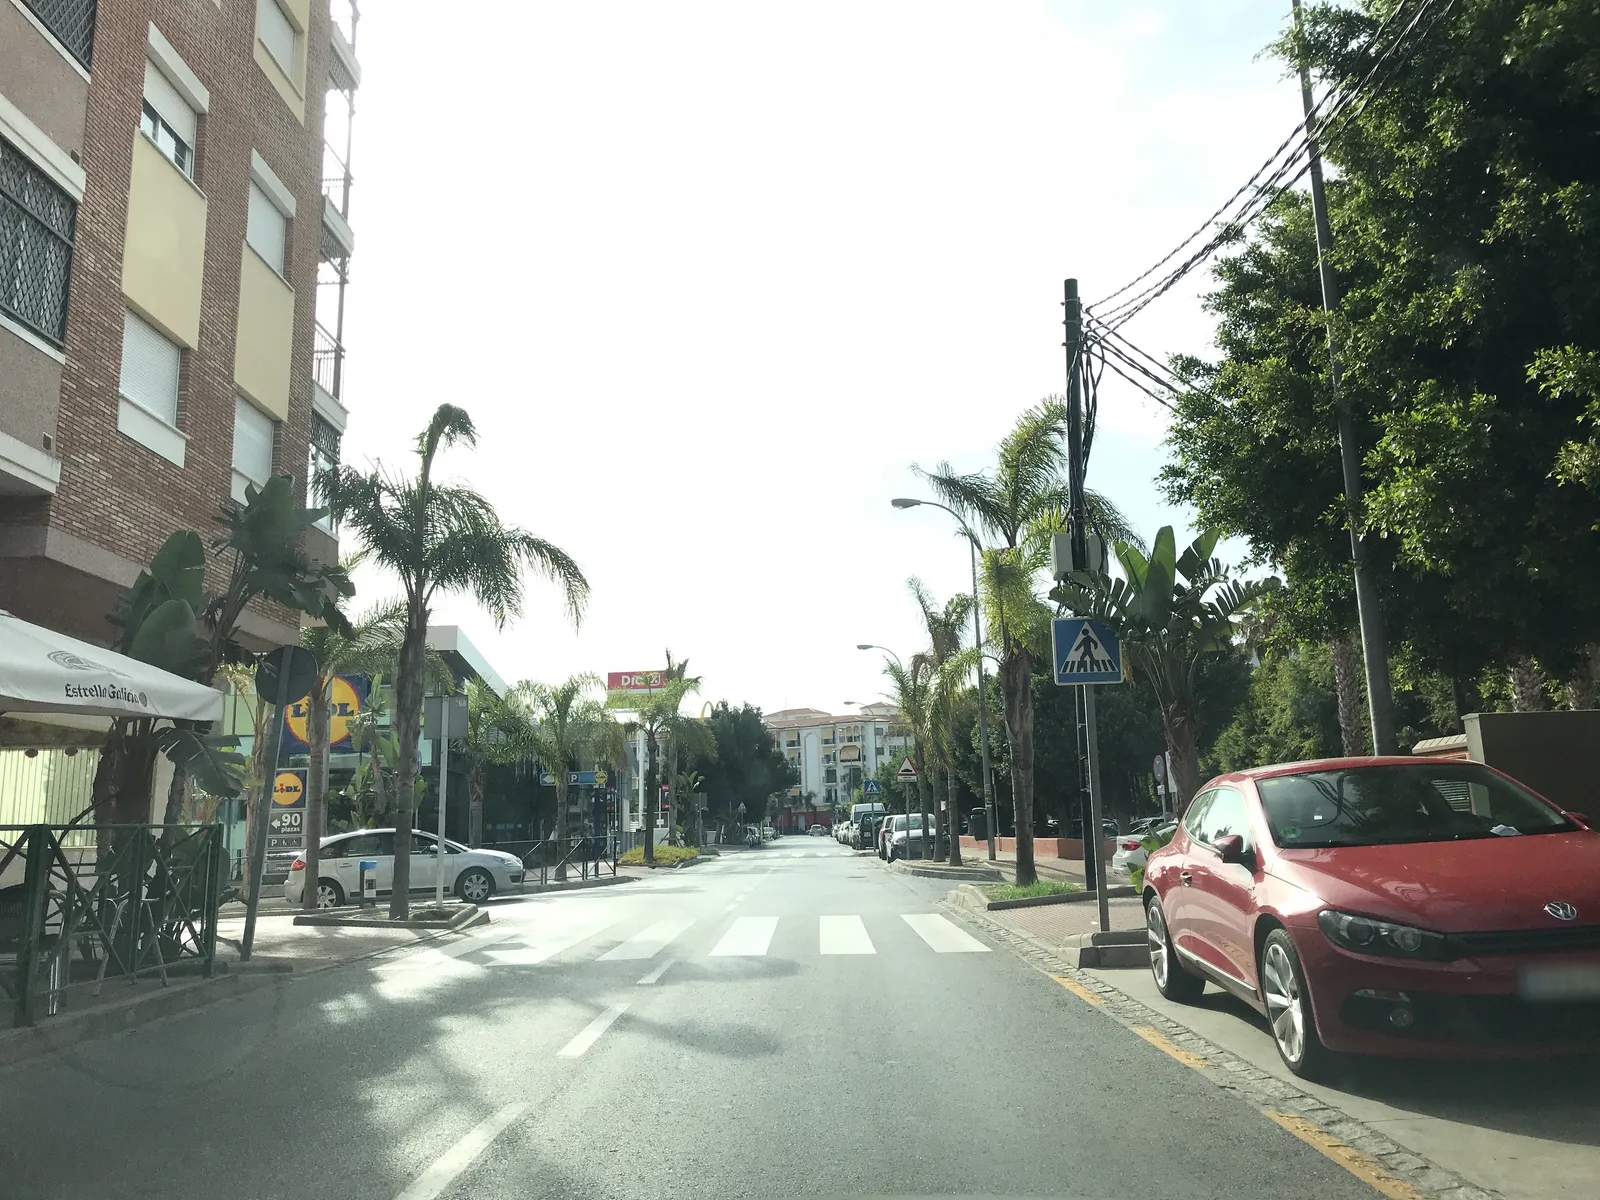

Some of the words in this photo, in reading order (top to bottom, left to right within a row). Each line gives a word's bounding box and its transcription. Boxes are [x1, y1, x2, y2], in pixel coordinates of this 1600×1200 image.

[65, 683, 107, 698] Estrella
[108, 684, 140, 704] Galicia
[570, 774, 578, 783] P
[281, 813, 301, 827] 90
[281, 826, 300, 834] plazas
[271, 839, 278, 847] P
